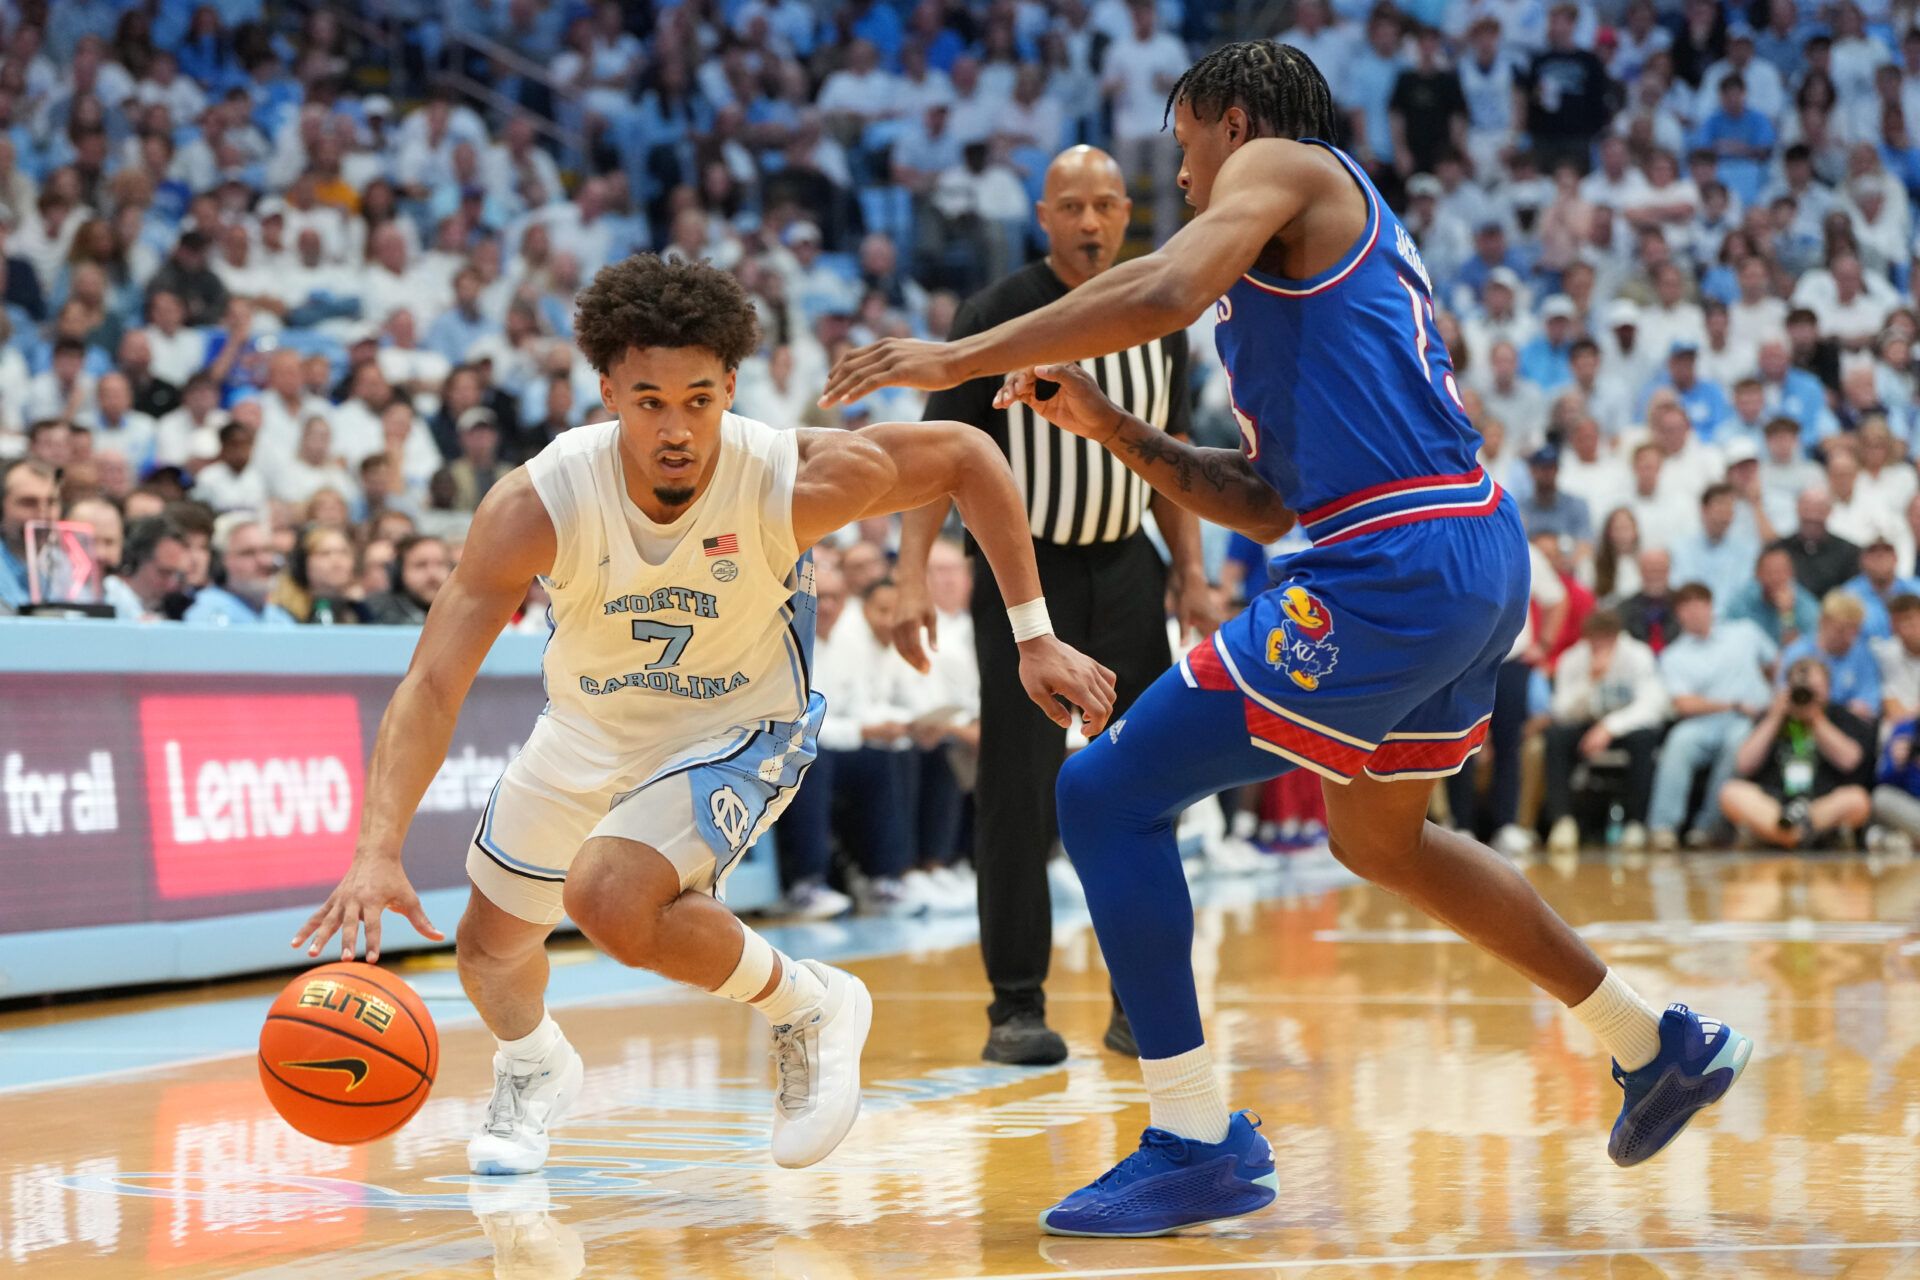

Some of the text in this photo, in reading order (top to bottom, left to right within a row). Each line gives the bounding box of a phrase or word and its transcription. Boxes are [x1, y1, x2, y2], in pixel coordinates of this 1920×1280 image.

[604, 587, 719, 618] NORTH
[632, 619, 694, 670] 7
[1291, 639, 1316, 661] KU
[579, 671, 749, 699] CAROLINA
[4, 751, 118, 834] for all
[165, 740, 352, 842] Lenovo
[299, 984, 393, 1034] ELITE
